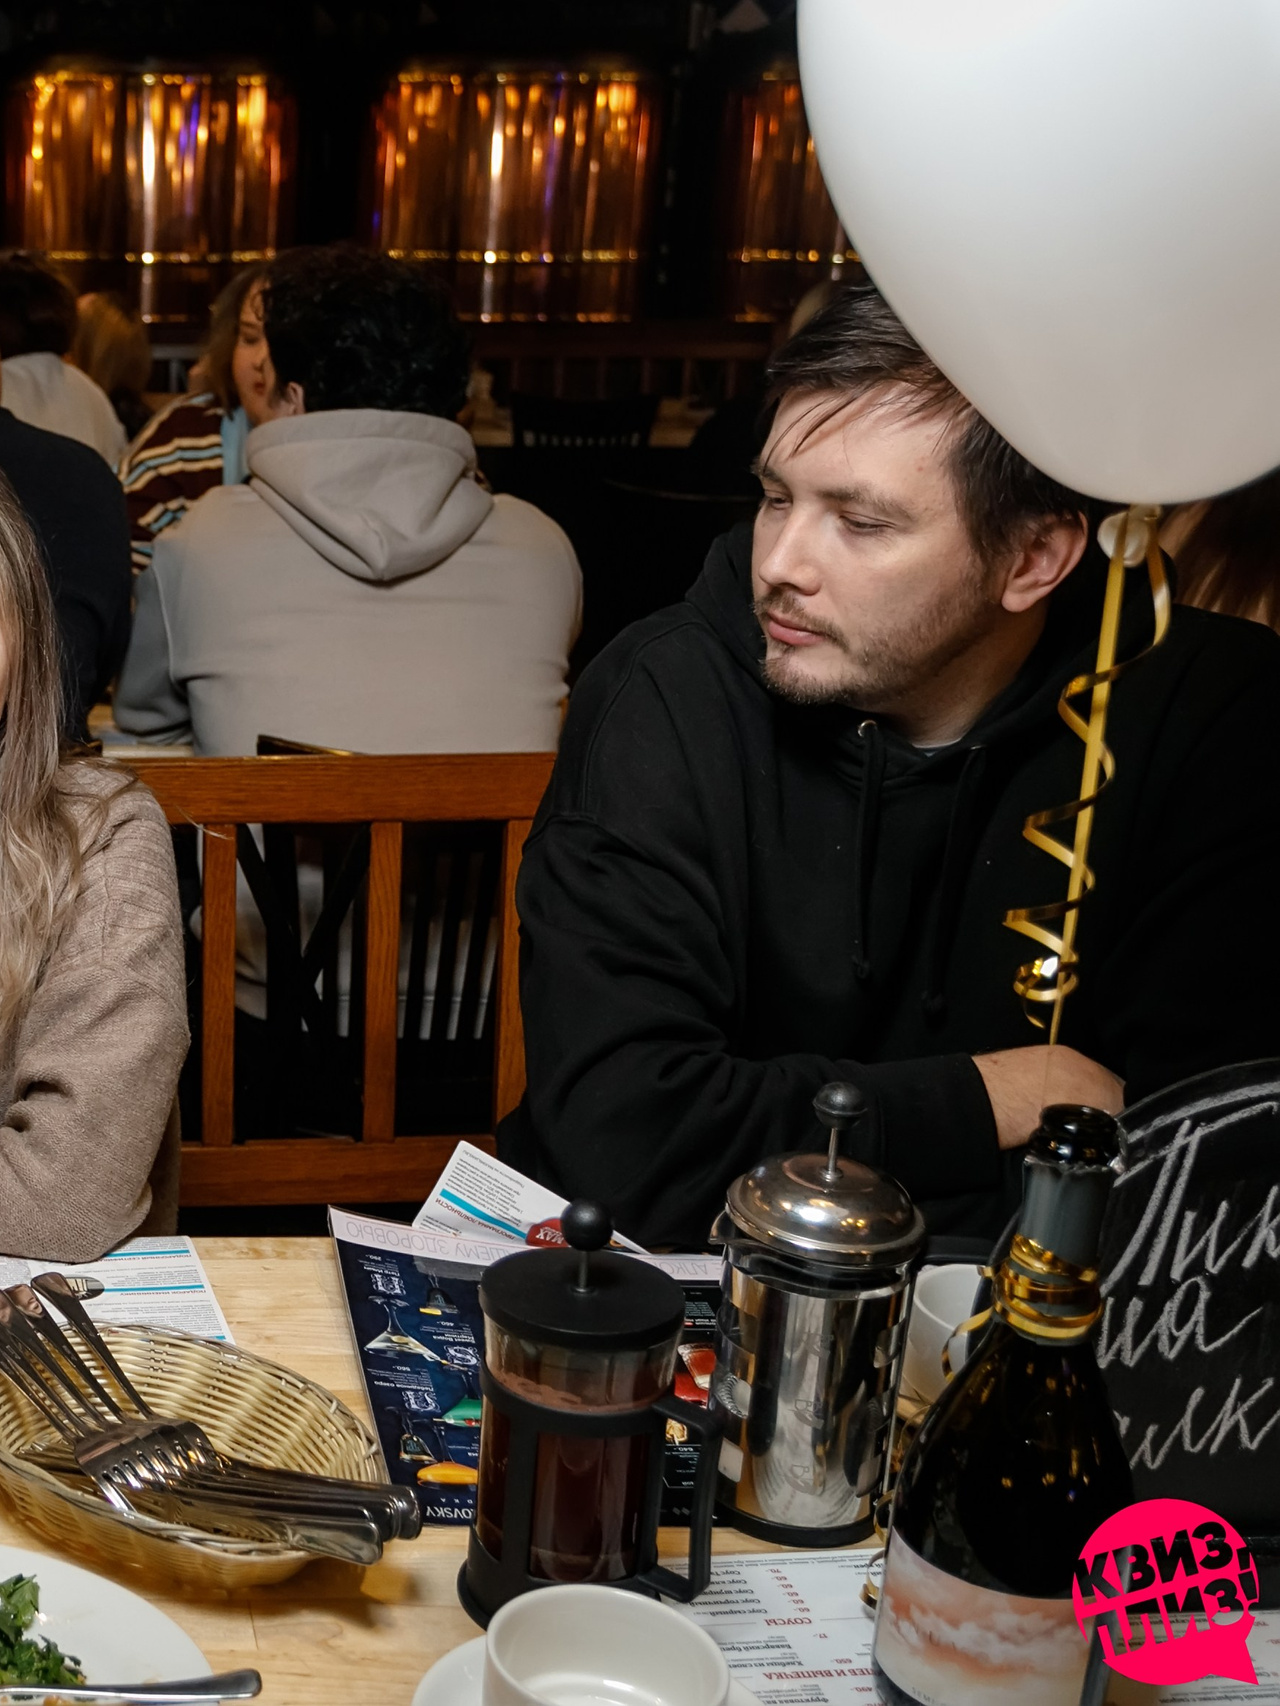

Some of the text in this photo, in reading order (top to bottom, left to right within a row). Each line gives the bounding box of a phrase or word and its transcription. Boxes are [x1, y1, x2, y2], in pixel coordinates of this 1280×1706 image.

[434, 1197, 477, 1224] ЛОЯЛЬНОСТИ
[346, 1221, 450, 1257] ЗДОРОВЬЮ
[455, 1242, 508, 1260] ШЕМУ
[658, 1261, 708, 1277] АЛКО
[426, 1505, 474, 1519] OVSKY
[709, 1609, 746, 1617] сырный
[763, 1616, 812, 1627] СОУСЫ
[743, 1643, 792, 1653] Баварский
[765, 1660, 804, 1668] Хлебцы
[762, 1666, 876, 1682] ЛЕБ И ВЫПЕЧКА
